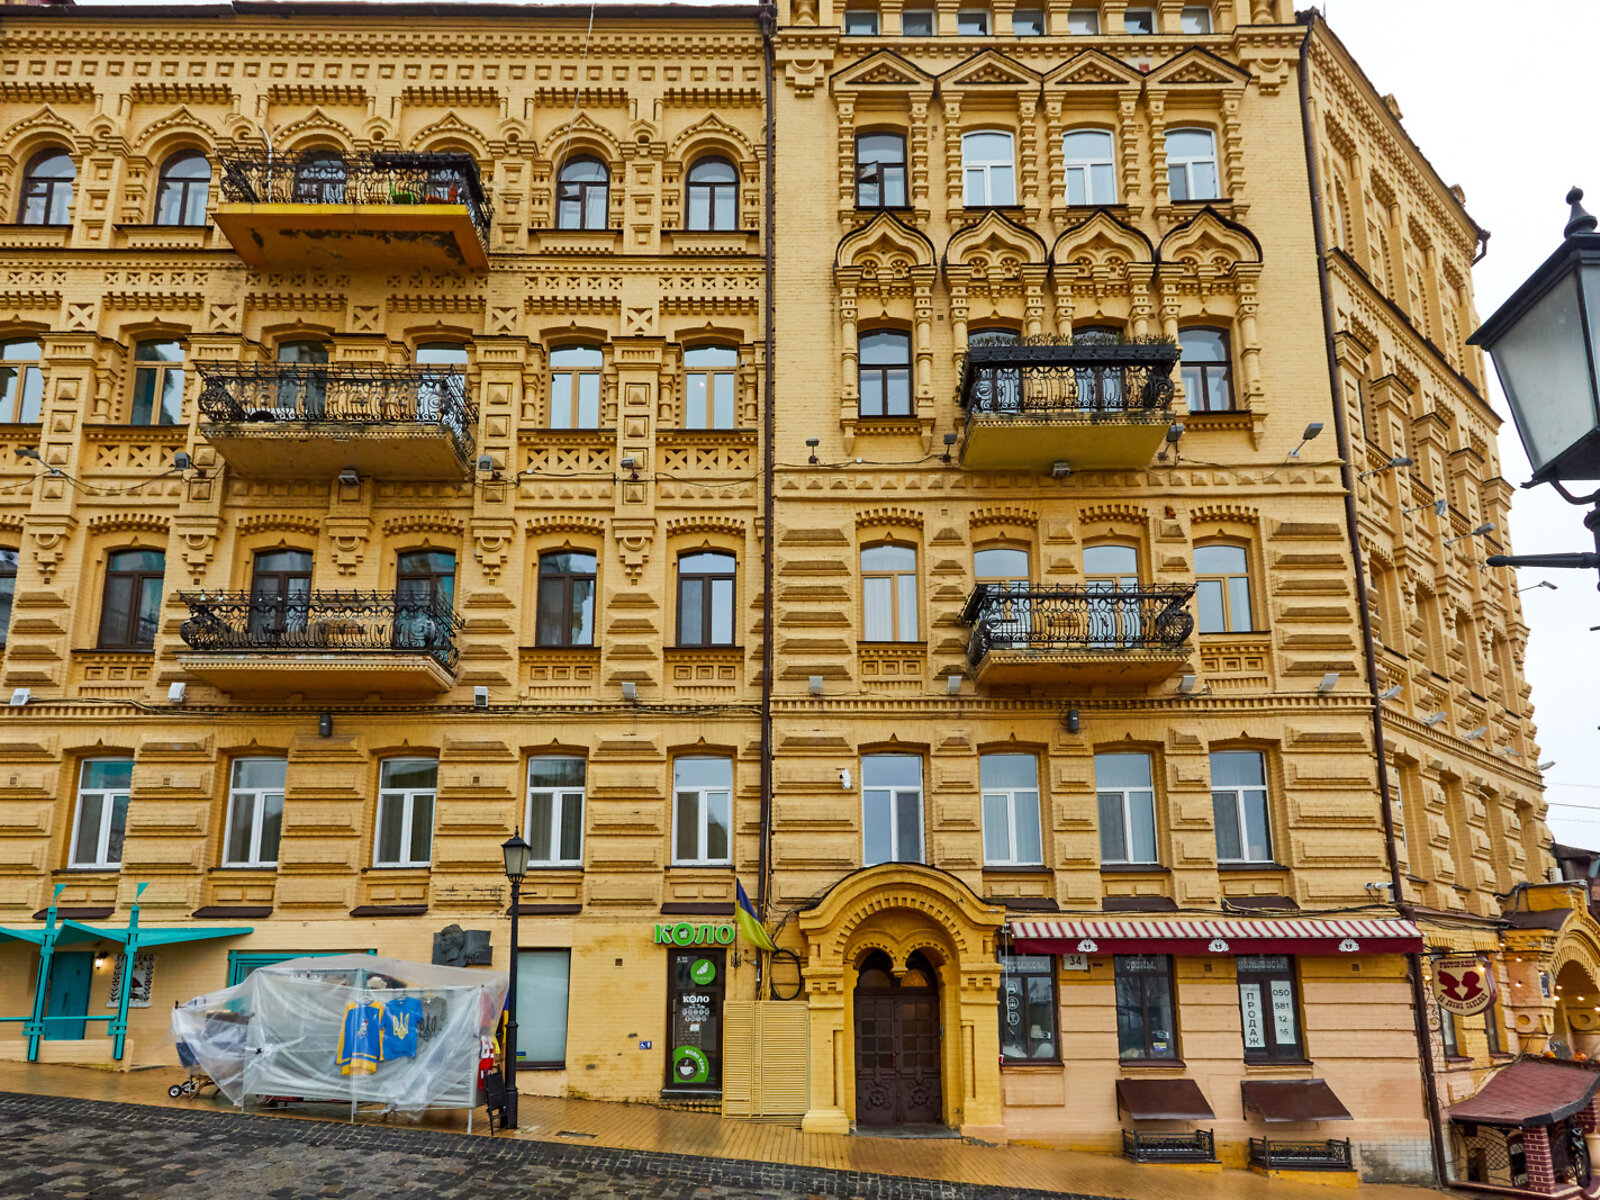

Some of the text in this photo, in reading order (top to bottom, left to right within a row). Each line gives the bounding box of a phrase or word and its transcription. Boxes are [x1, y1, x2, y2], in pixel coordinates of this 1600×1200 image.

[654, 922, 735, 946] КОЛО
[1069, 955, 1082, 966] 34
[1272, 989, 1290, 997] 050
[683, 995, 710, 1003] КОЛО
[1275, 1002, 1289, 1010] 581
[1246, 992, 1260, 1046] ПРОДАЖ
[1278, 1015, 1288, 1023] 12
